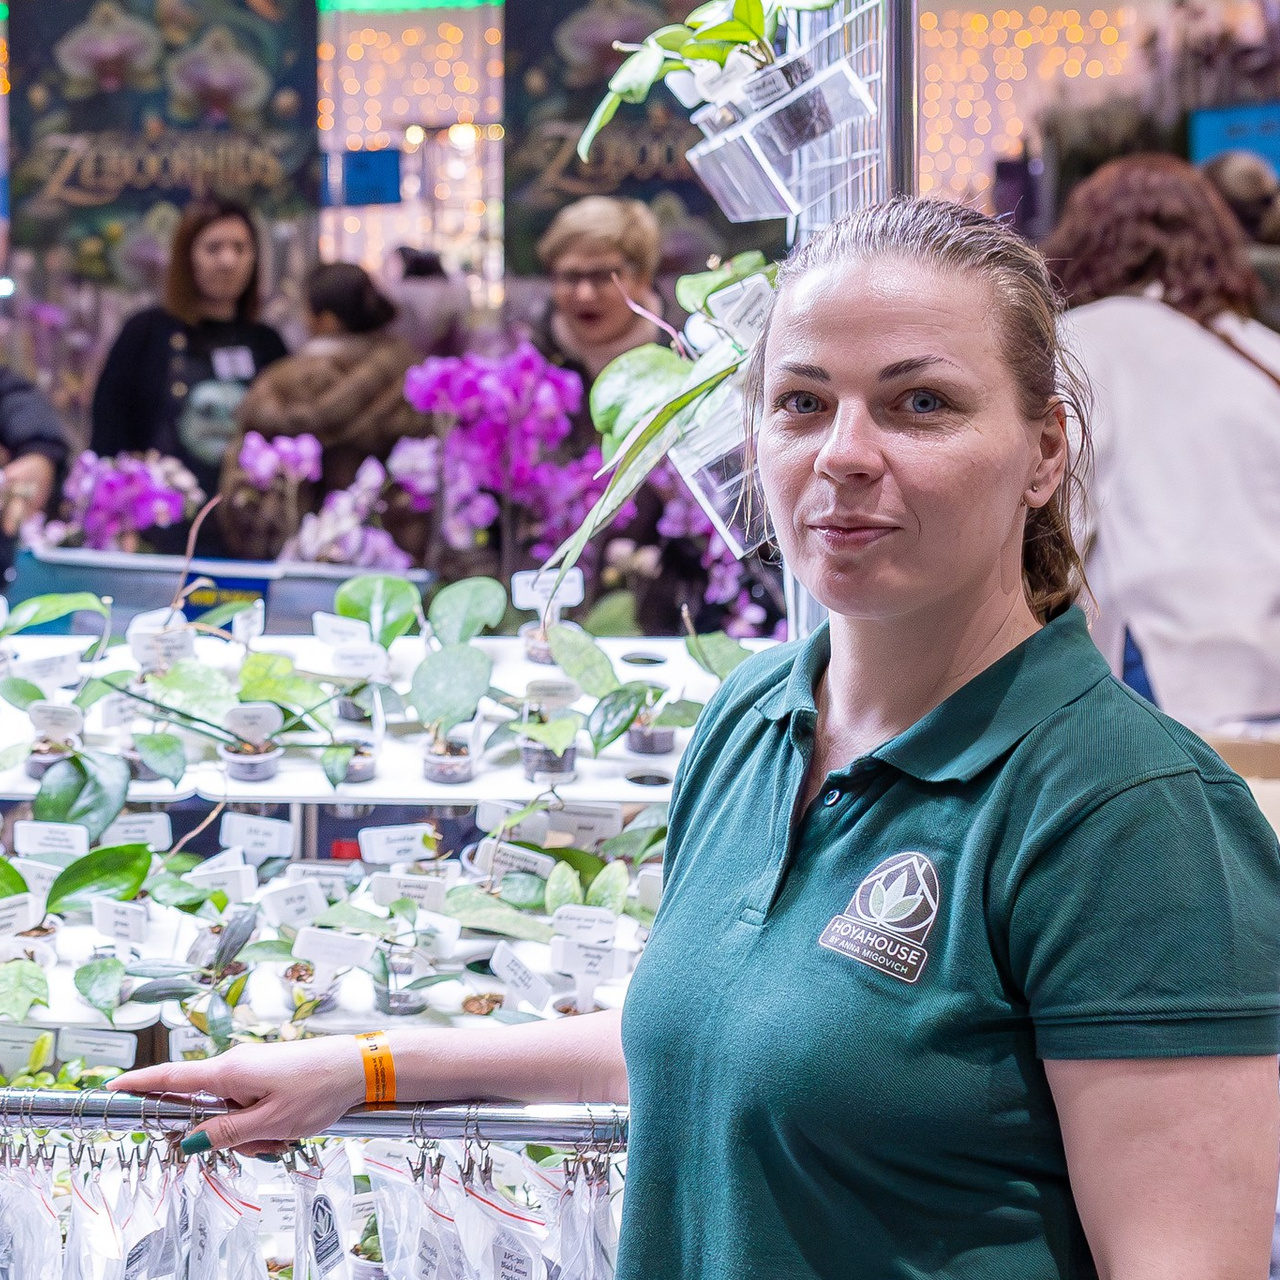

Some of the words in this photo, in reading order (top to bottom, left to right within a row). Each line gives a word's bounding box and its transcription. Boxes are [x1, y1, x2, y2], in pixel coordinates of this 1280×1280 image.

[828, 936, 840, 944] BY
[839, 937, 861, 954] ANNA
[862, 948, 909, 975] MIGOVICH
[831, 921, 921, 966] HOYAHOUSE
